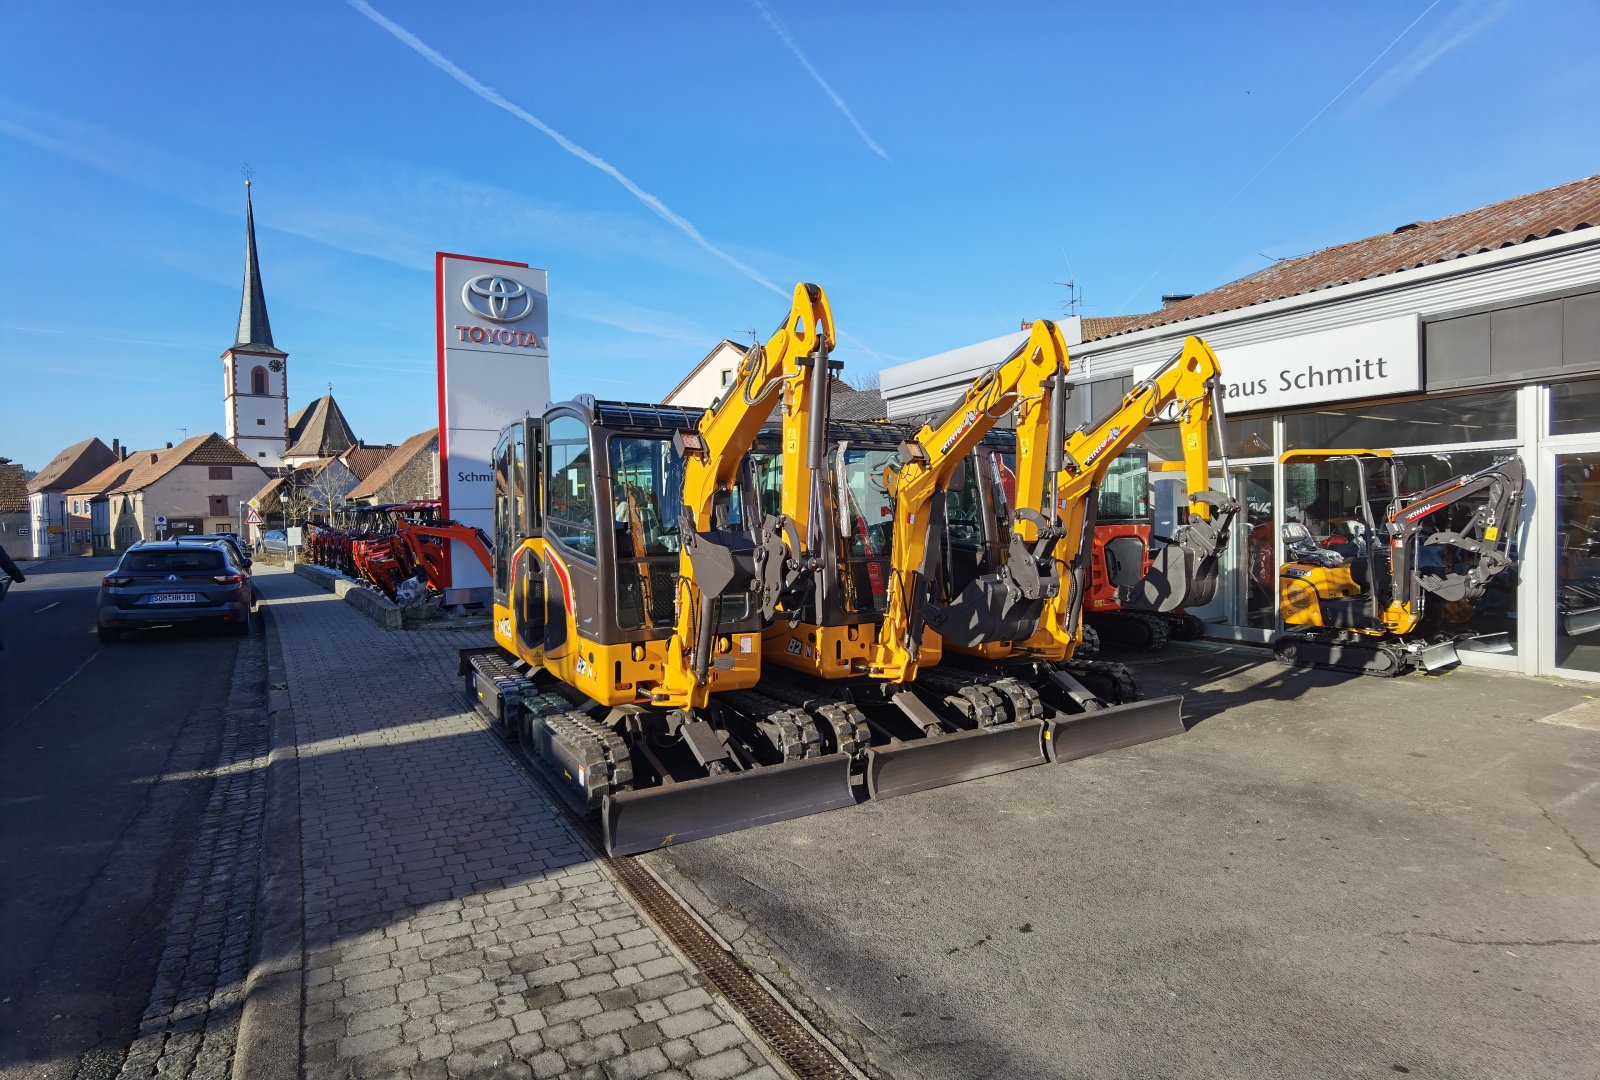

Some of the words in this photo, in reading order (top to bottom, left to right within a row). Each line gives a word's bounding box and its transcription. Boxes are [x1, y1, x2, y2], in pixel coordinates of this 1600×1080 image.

[455, 325, 540, 348] TOYOTA
[1279, 357, 1388, 392] Schmitt
[457, 471, 494, 482] Schmi
